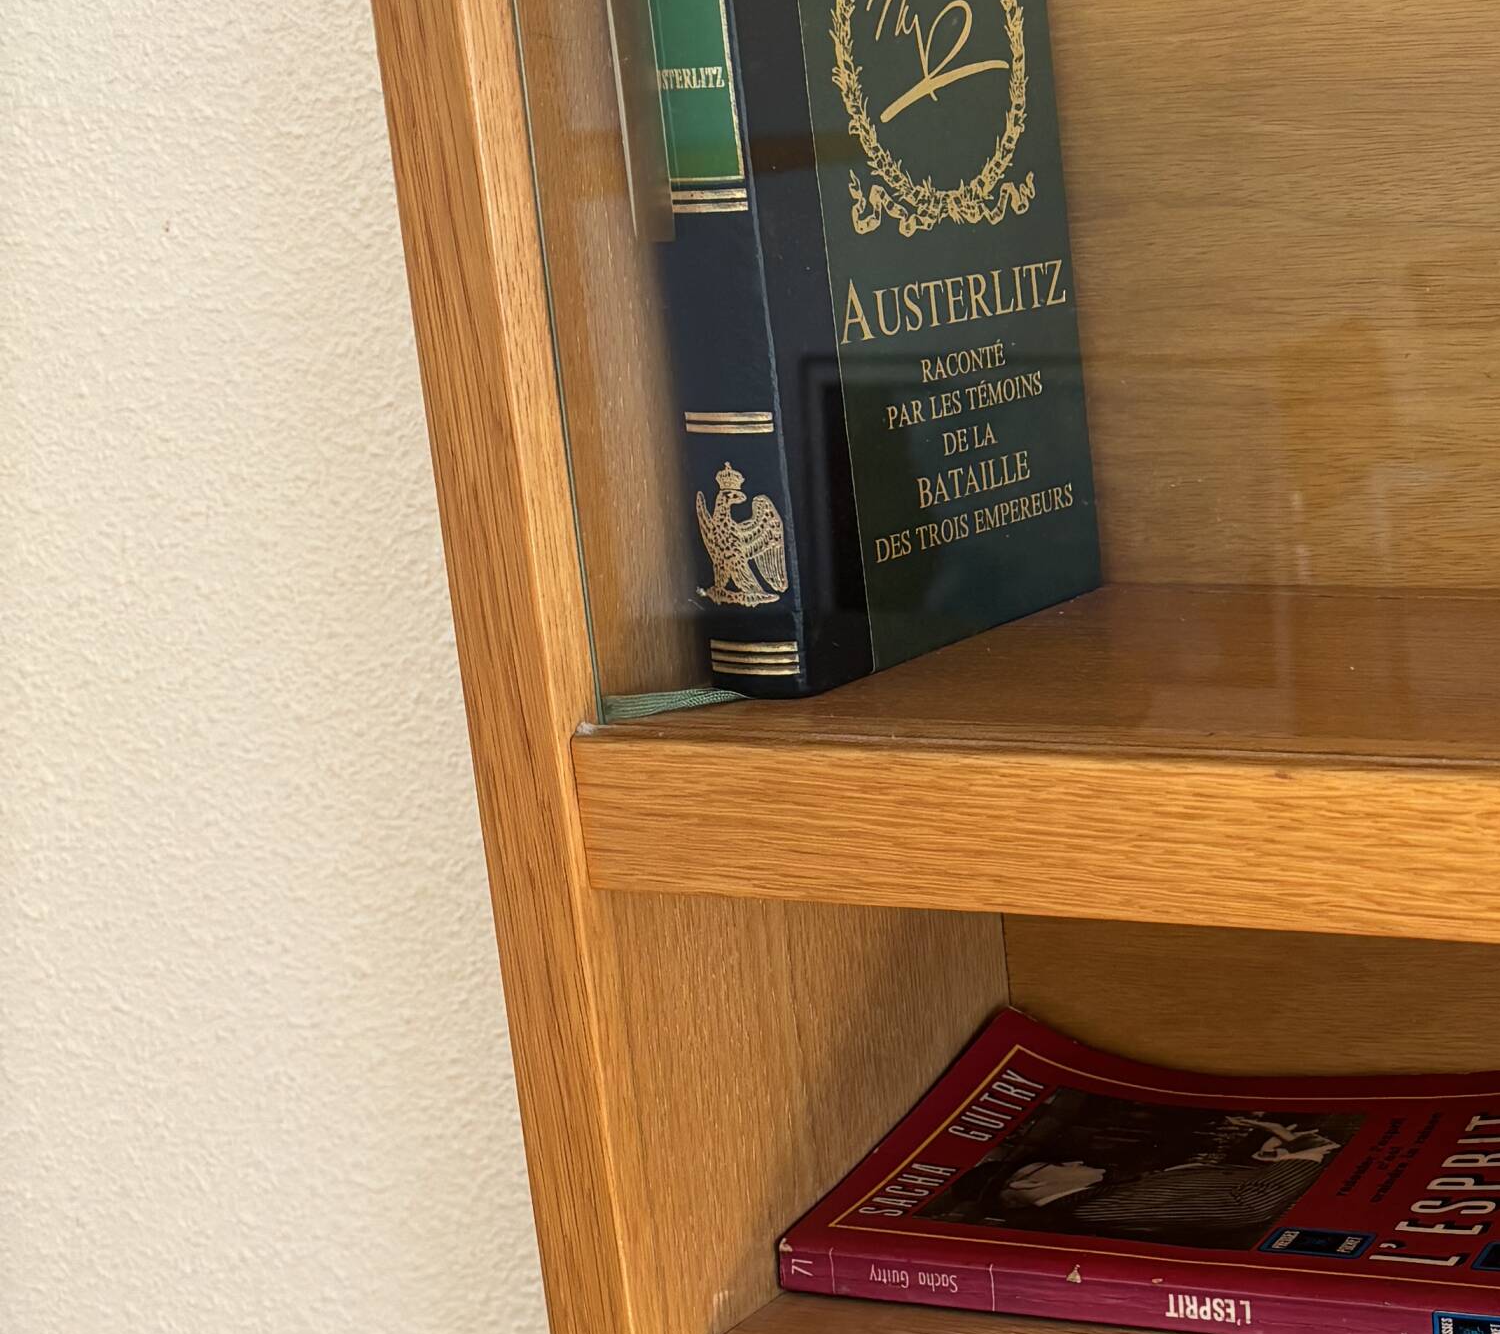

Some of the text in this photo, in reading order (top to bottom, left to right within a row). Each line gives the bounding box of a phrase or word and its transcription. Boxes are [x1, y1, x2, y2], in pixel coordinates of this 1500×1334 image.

[656, 66, 725, 89] STERLITZ
[840, 259, 1067, 345] AUSTERLITZ
[920, 338, 1006, 383] RACONTÉ
[886, 370, 1043, 430] PAR LES TÉMOINS
[942, 422, 998, 456] DE LA
[917, 450, 1031, 509] BATAILLE
[875, 483, 1074, 563] DES TROIS EMPEREURS
[858, 1069, 1044, 1217] SACHA GUITRY
[869, 1264, 958, 1293] Sacha Guitry
[1165, 1293, 1252, 1326] L'ESPRIT
